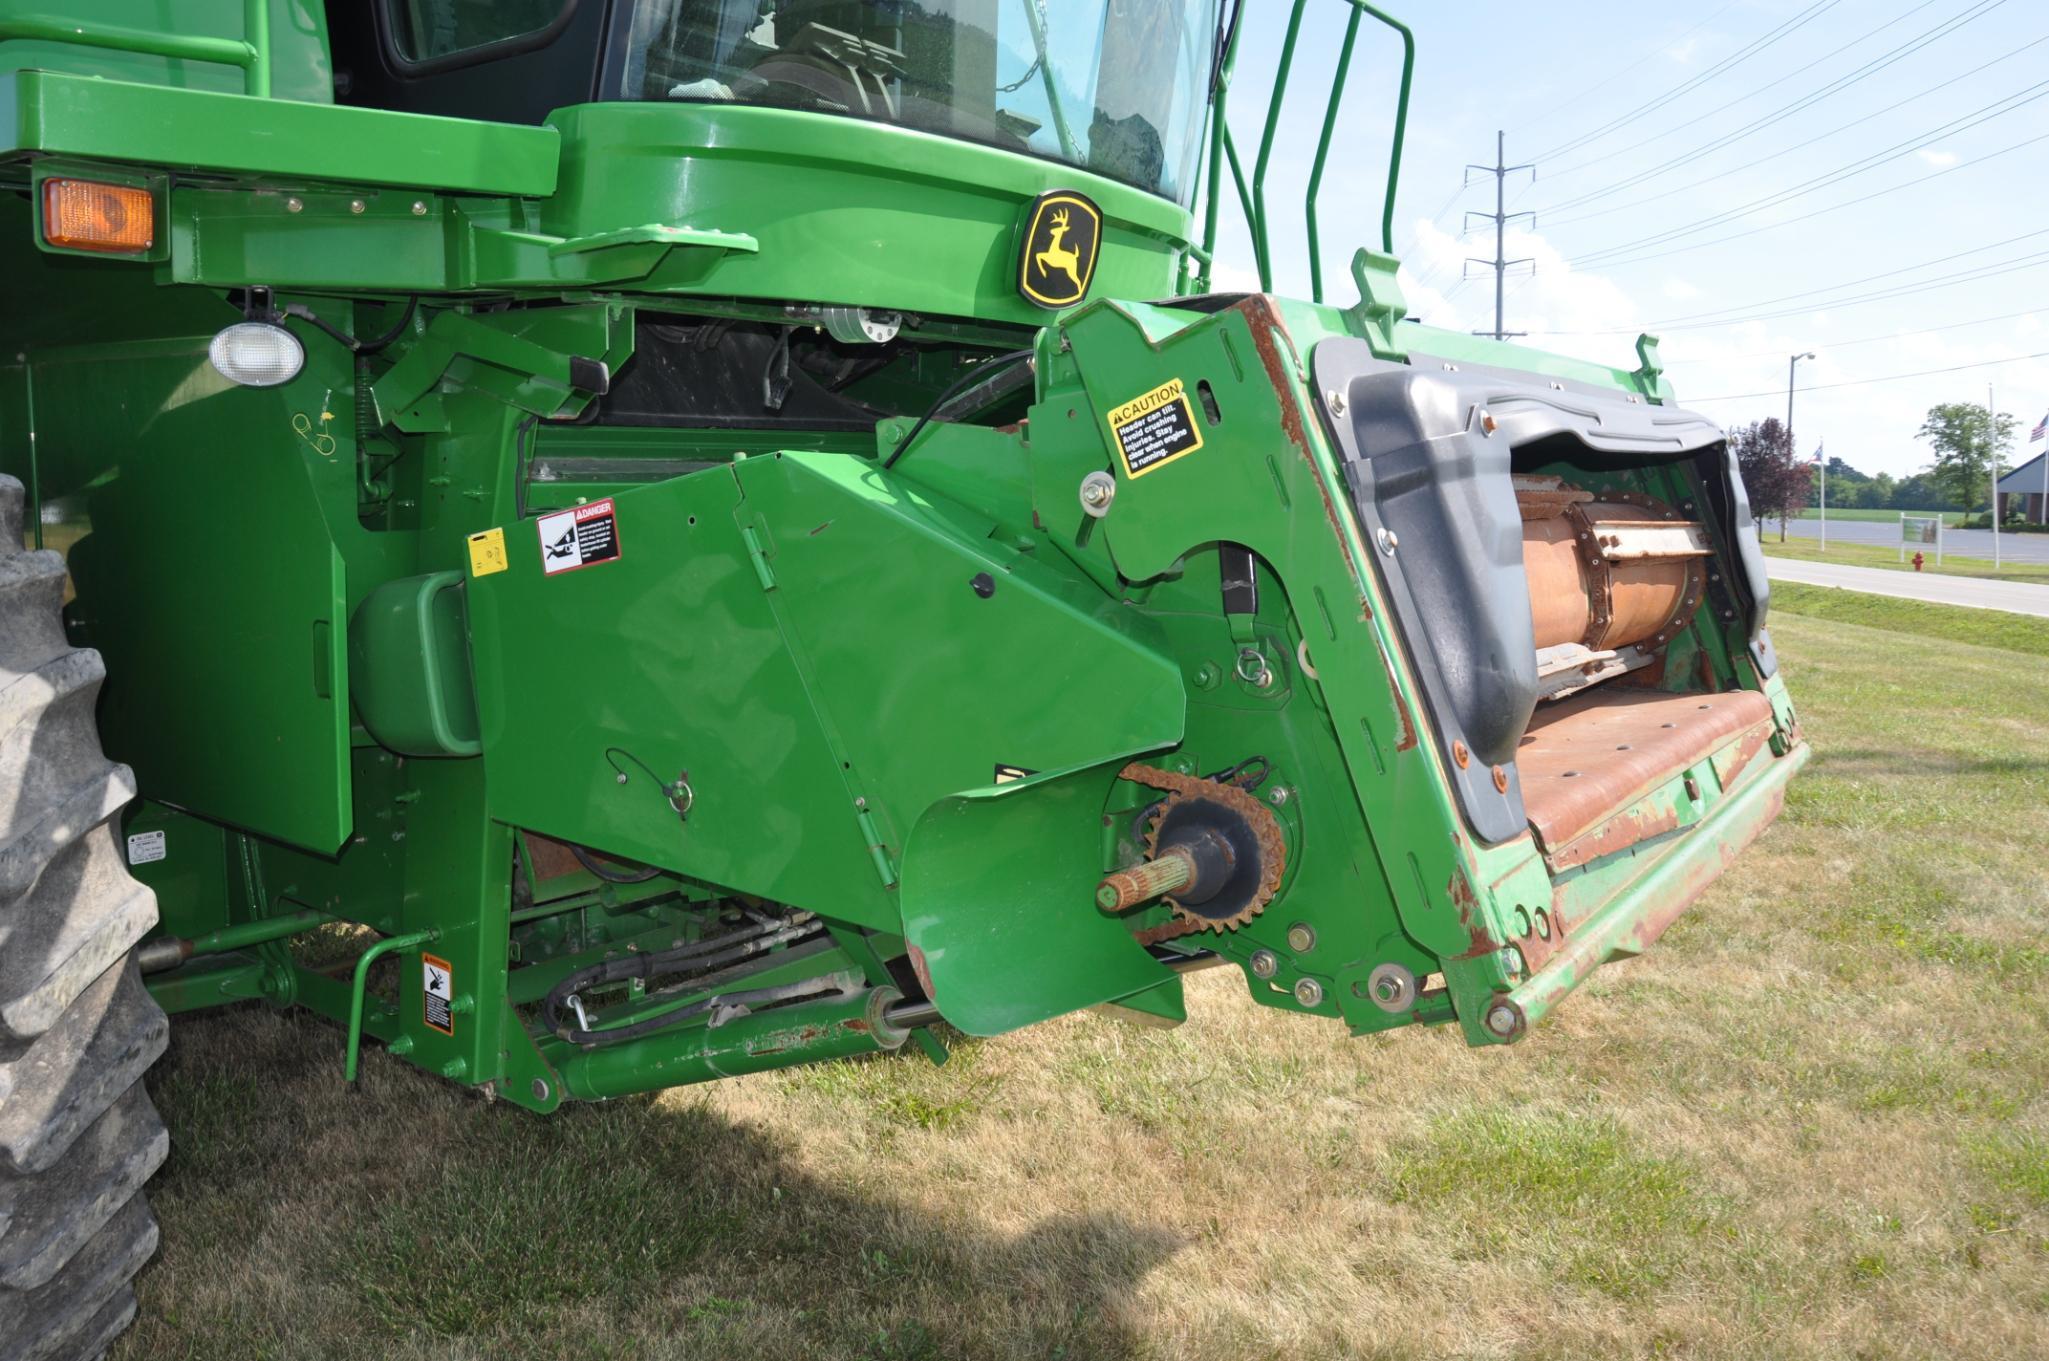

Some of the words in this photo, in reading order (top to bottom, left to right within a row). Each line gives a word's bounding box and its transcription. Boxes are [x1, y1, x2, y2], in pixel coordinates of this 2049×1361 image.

[1122, 383, 1180, 420] CAUTION
[1119, 418, 1146, 436] Header
[1146, 411, 1161, 423] can
[1161, 404, 1176, 415] tilt.
[1122, 429, 1144, 445] Avoid
[1144, 413, 1177, 434] crushing
[1155, 425, 1173, 438] Stay
[1128, 448, 1145, 461] clear
[1145, 439, 1164, 452] when
[1163, 428, 1187, 444] engine
[1130, 460, 1138, 469] is
[1138, 448, 1169, 466] running.
[582, 502, 612, 518] DANGER
